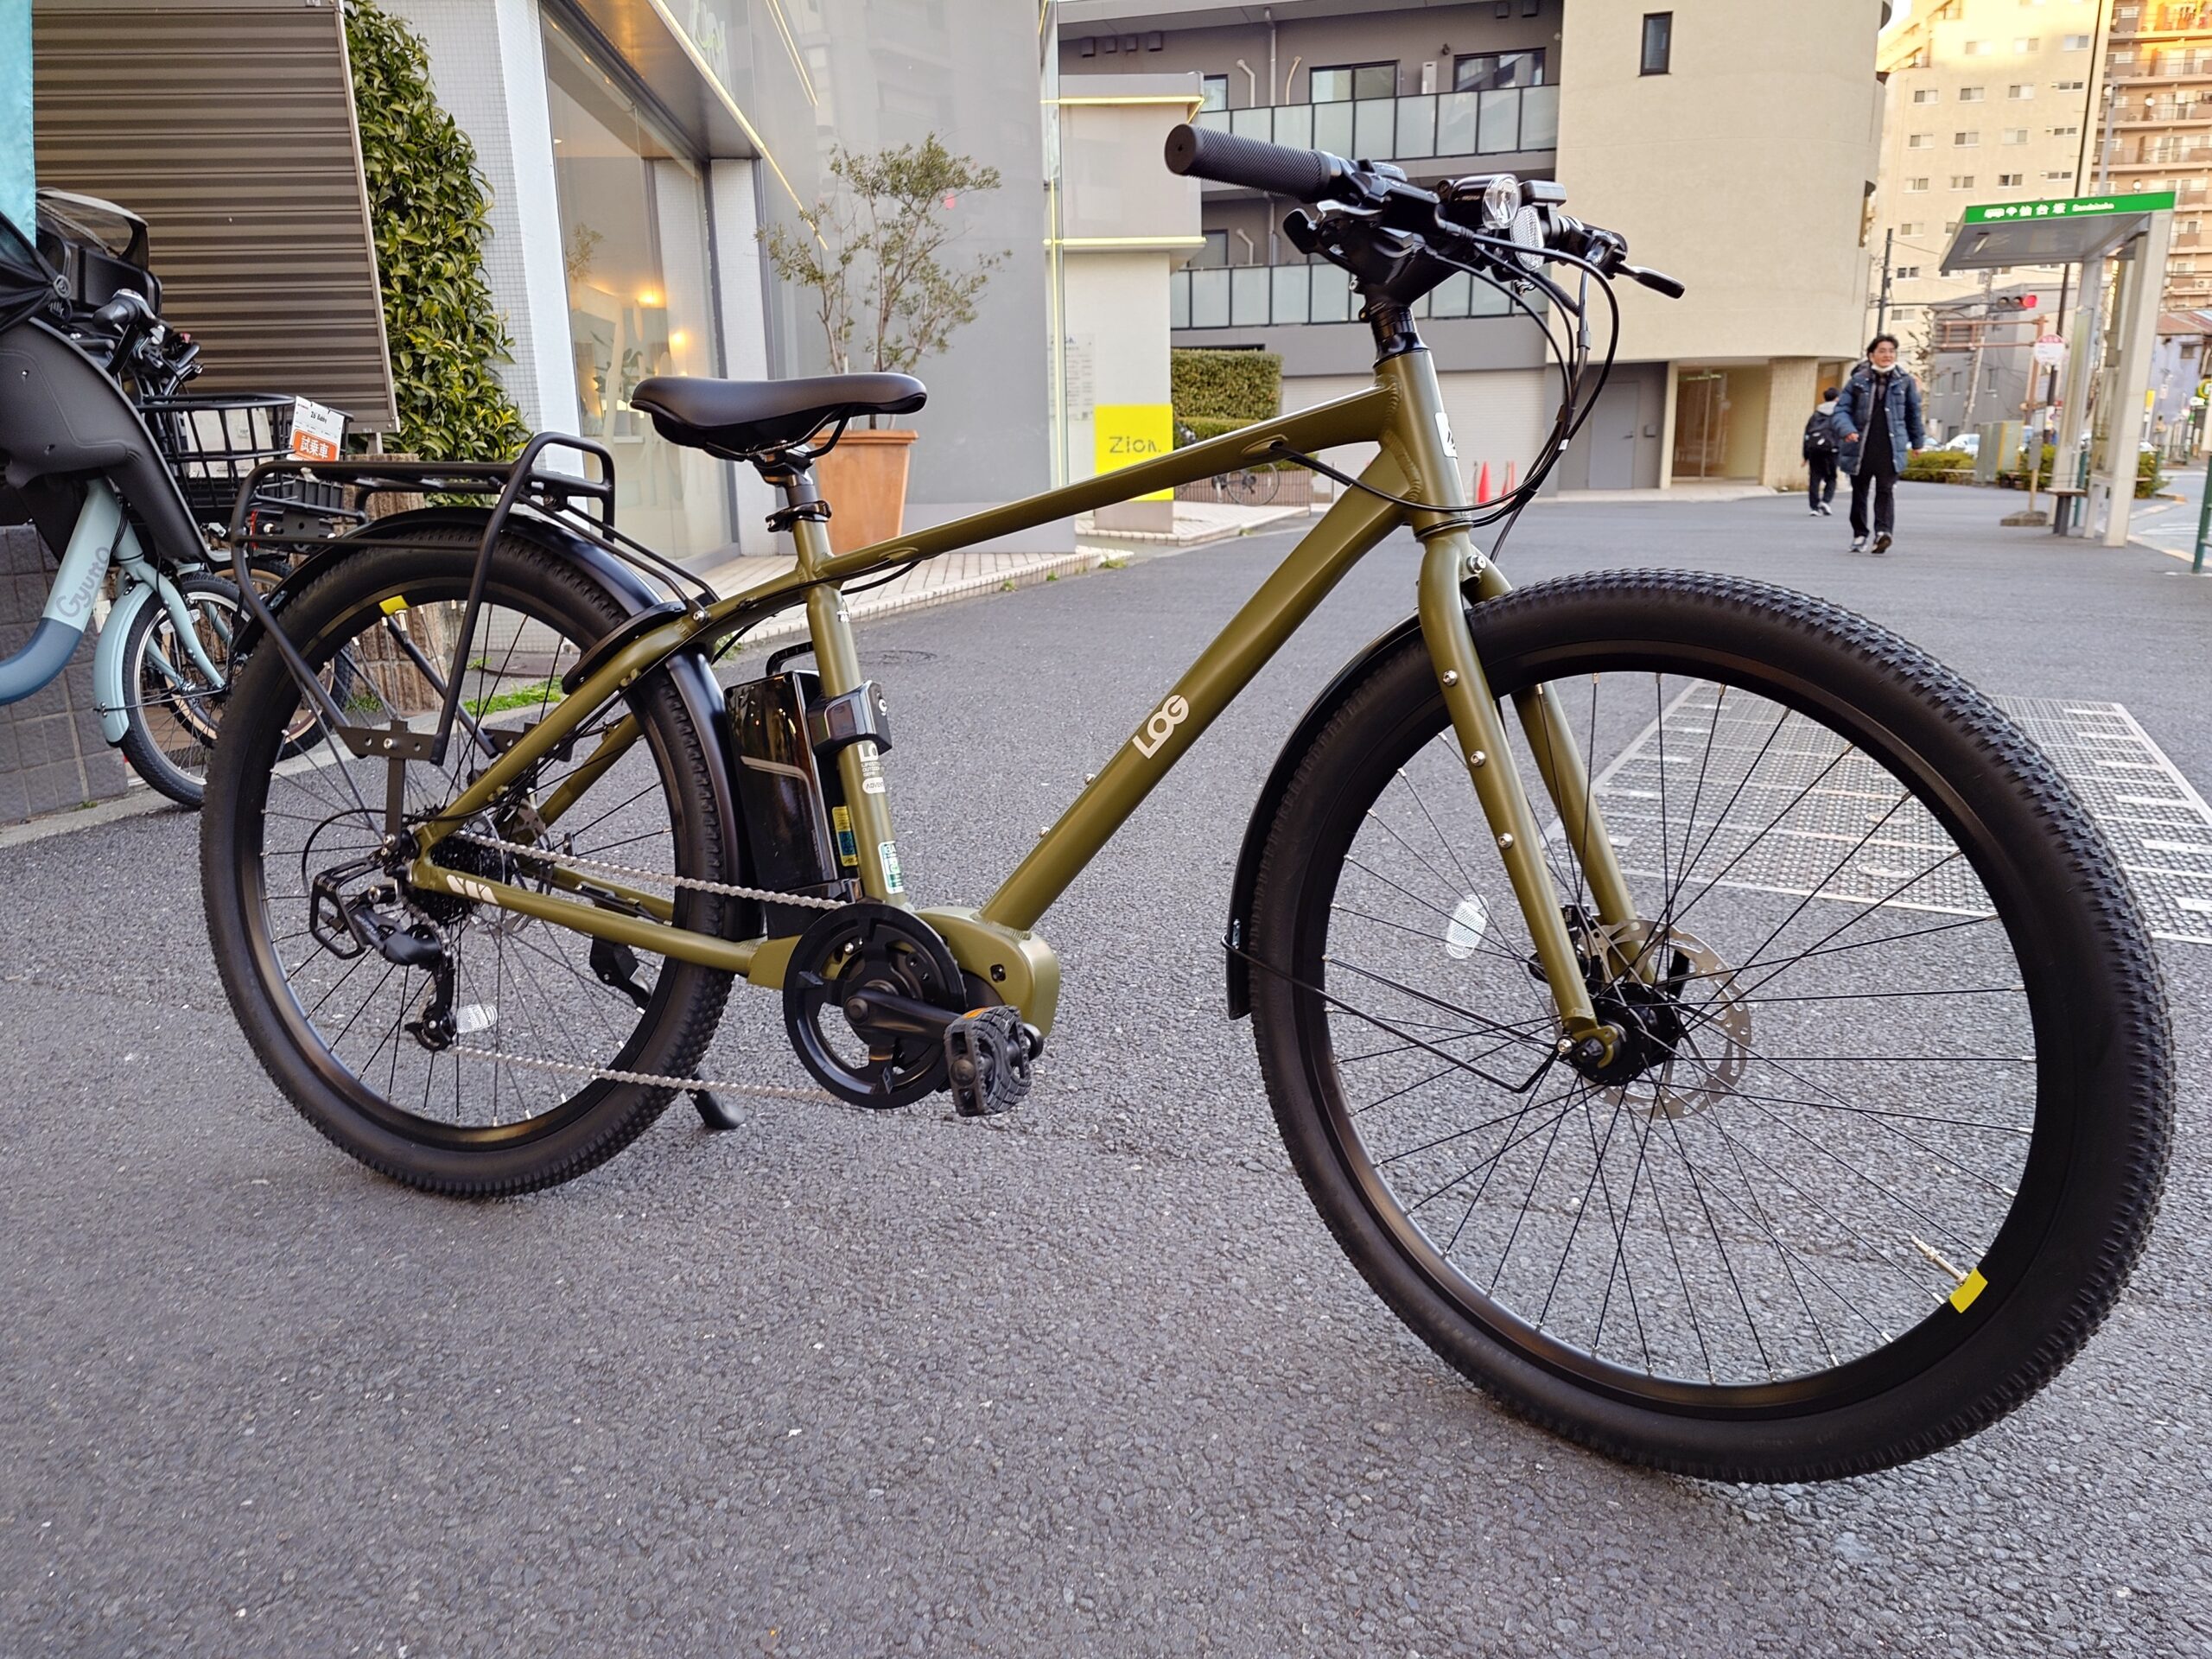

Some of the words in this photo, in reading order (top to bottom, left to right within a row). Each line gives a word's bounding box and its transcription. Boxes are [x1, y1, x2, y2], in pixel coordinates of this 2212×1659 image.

[300, 435, 329, 460] 試乗車
[1131, 694, 1190, 760] LOG
